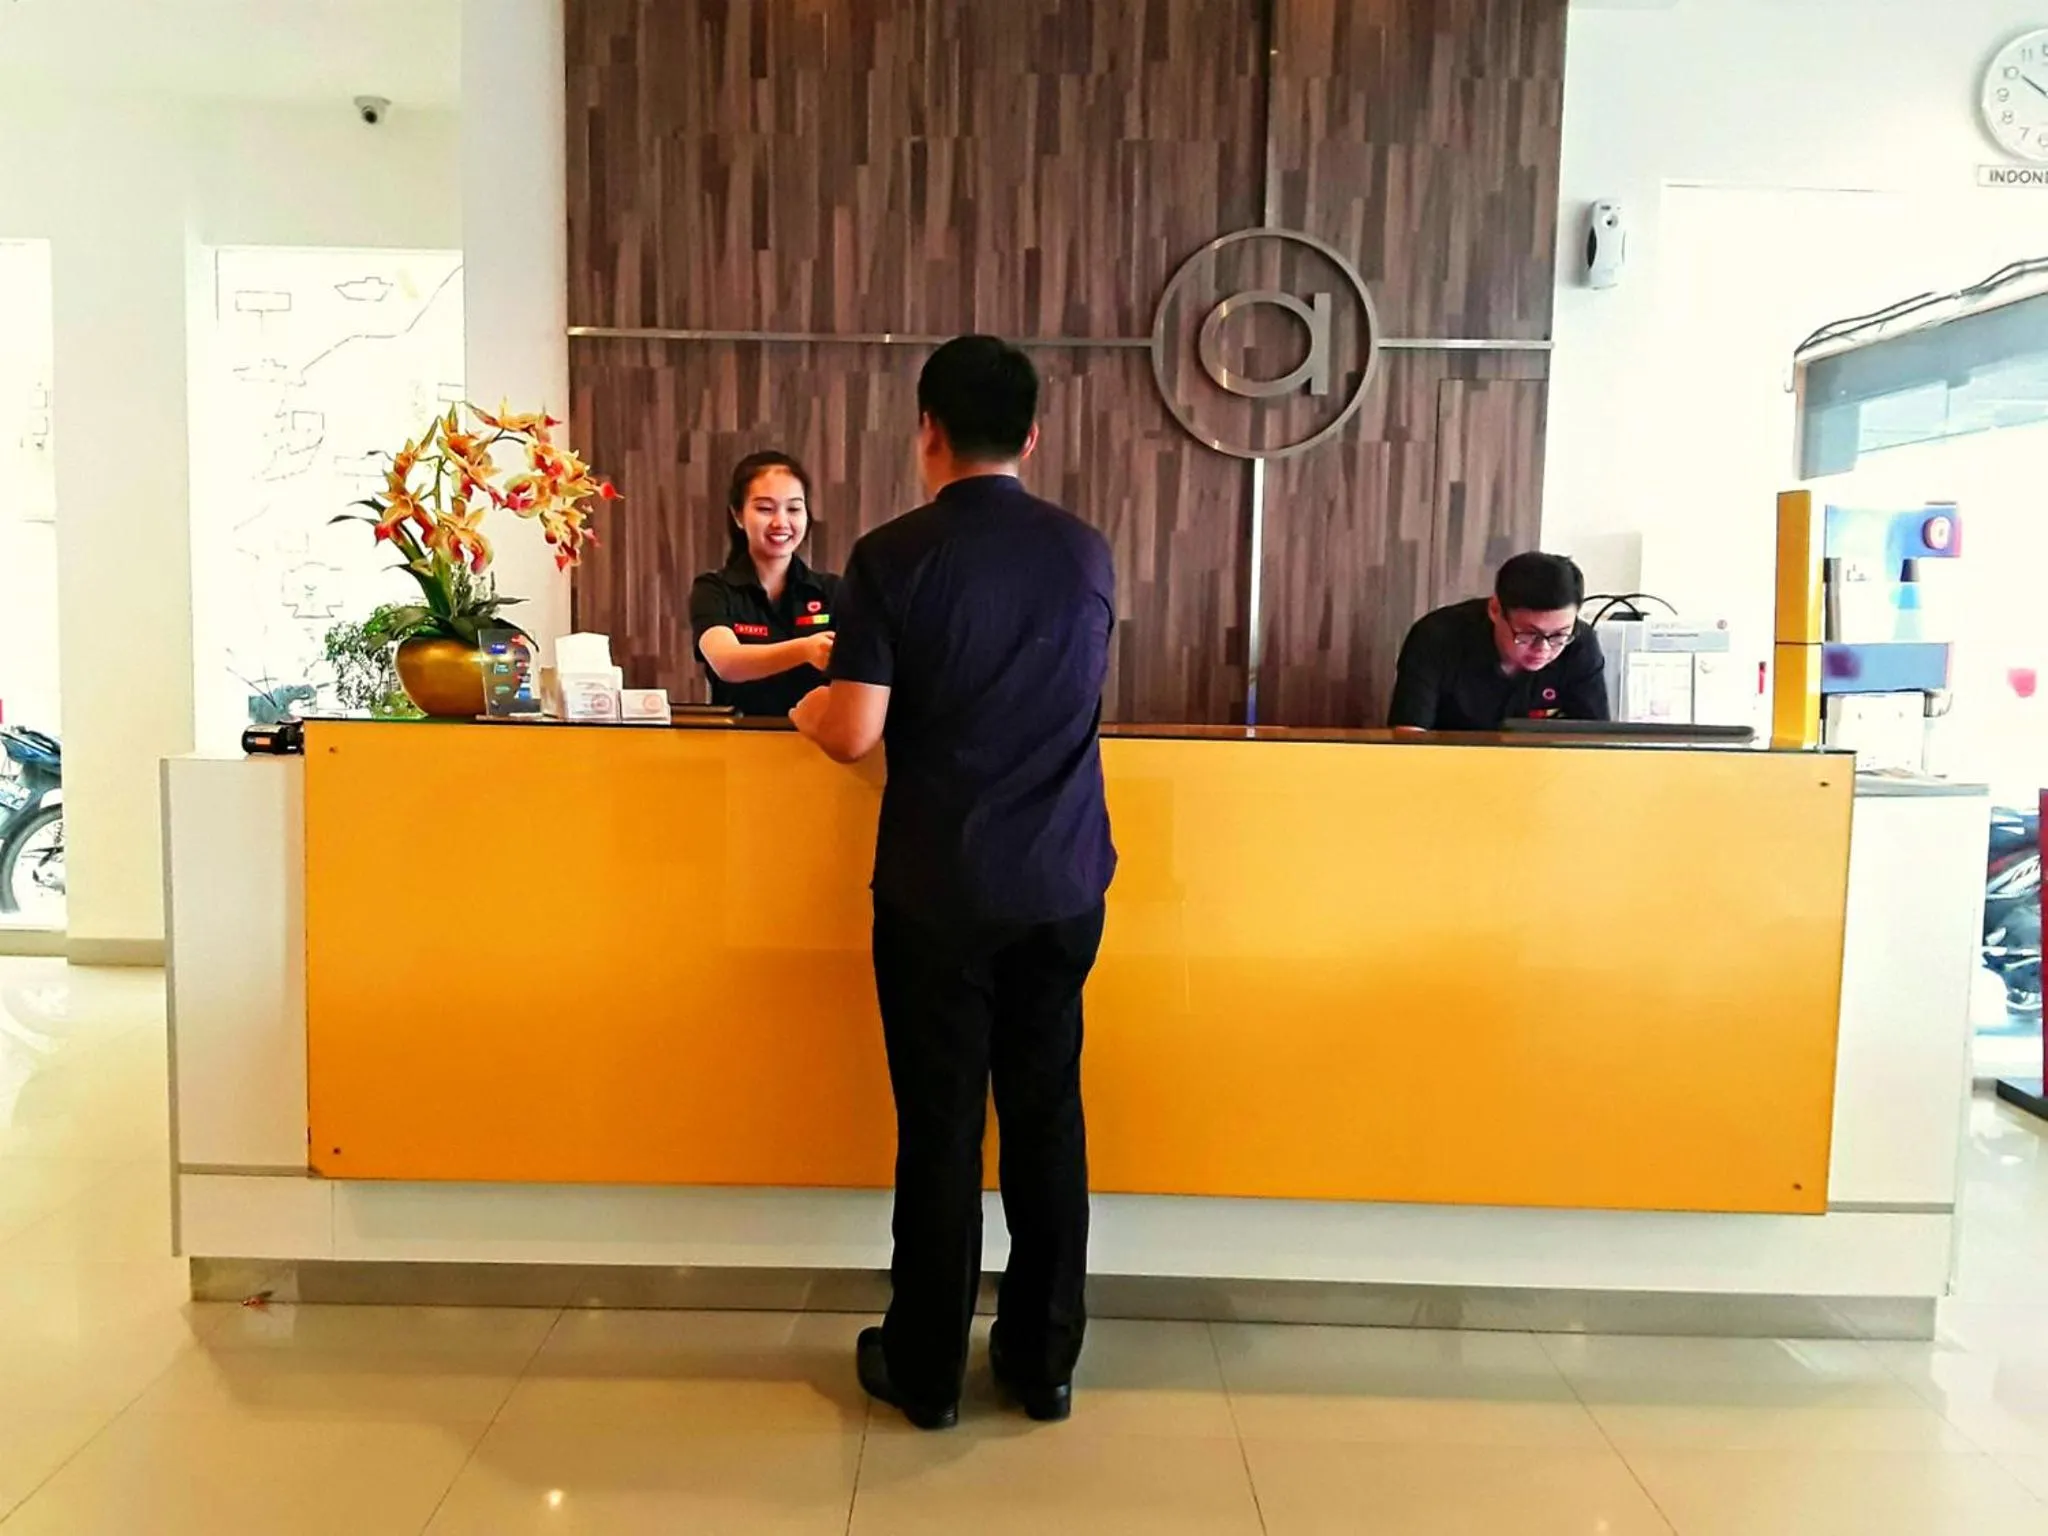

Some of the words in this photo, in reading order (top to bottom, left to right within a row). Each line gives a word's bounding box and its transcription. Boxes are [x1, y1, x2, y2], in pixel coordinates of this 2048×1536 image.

[1996, 87, 2010, 102] 9
[2001, 109, 2014, 125] 8
[2018, 126, 2030, 141] 7
